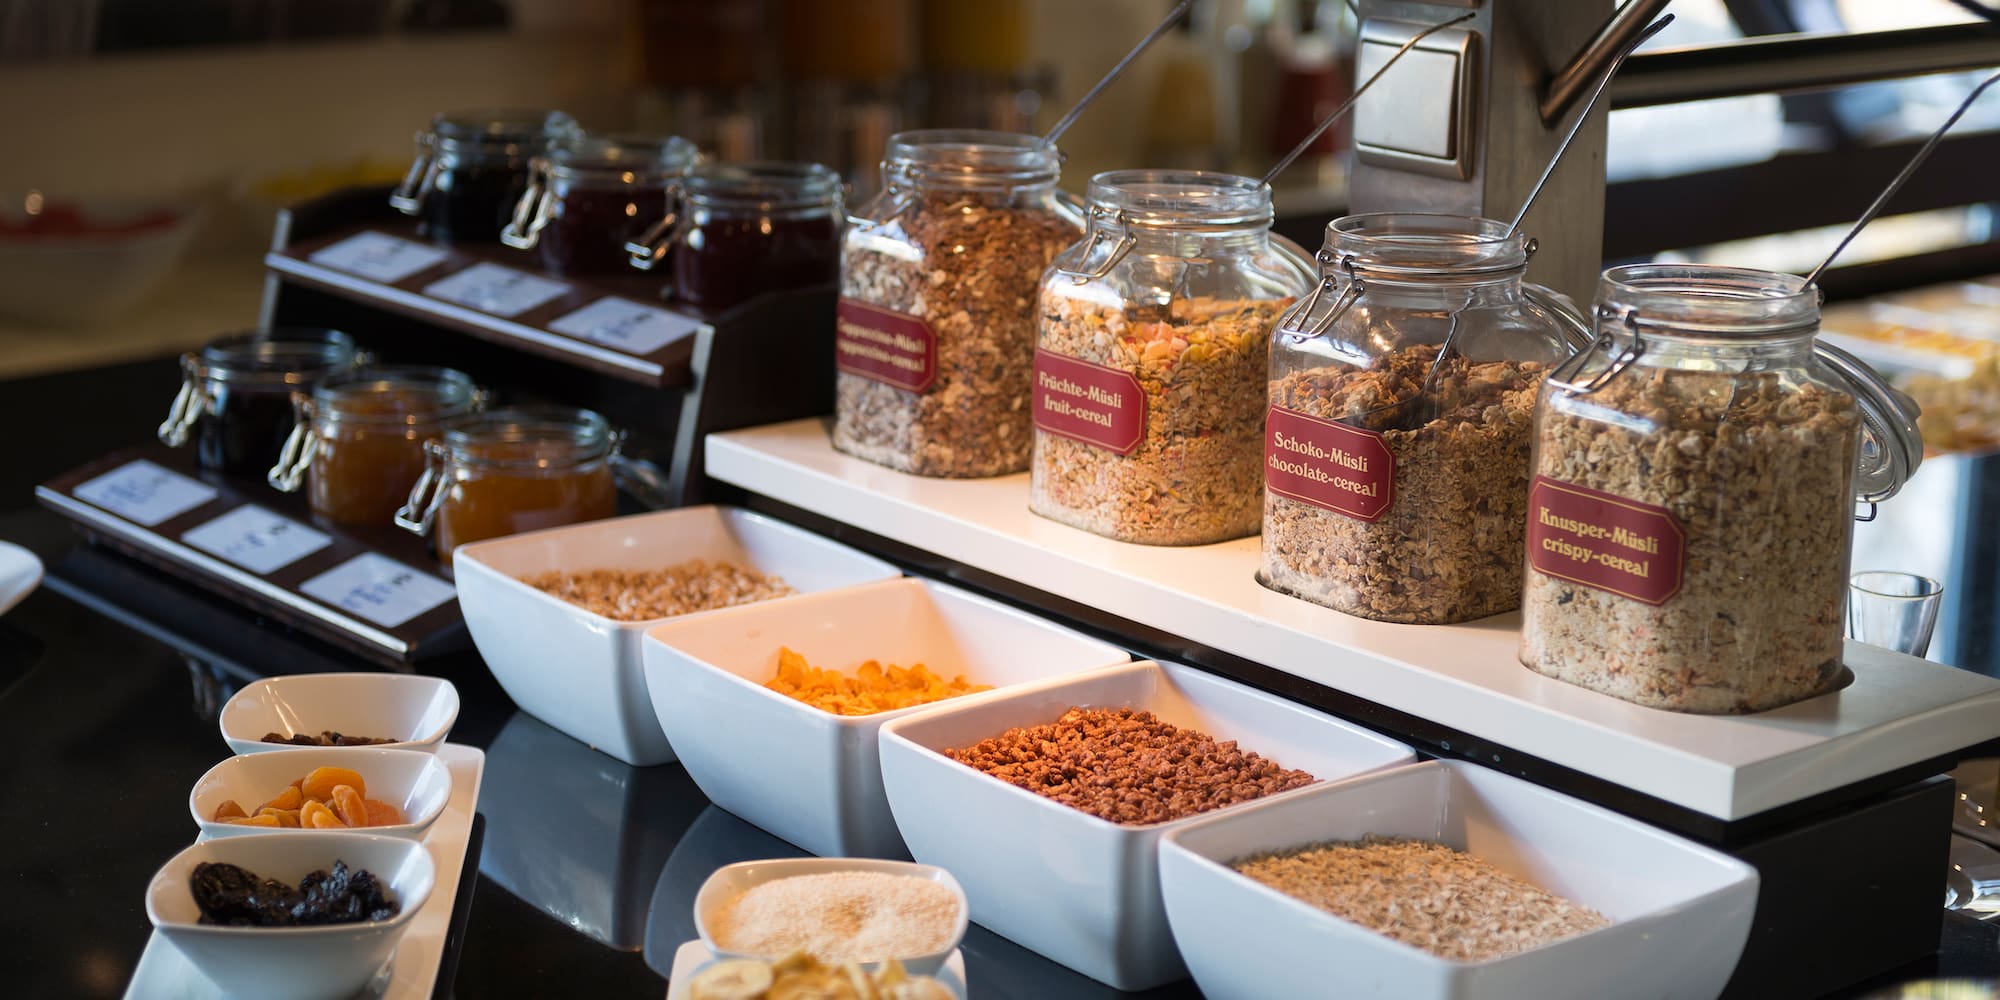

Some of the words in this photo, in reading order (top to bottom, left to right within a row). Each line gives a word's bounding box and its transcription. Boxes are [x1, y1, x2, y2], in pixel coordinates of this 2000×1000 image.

[1039, 371, 1122, 408] Früchte-Müsli
[1044, 394, 1112, 427] fruit-cereal
[1274, 431, 1368, 472] Schoko-Müsli
[1268, 453, 1377, 497] chocolate-cereal
[1539, 506, 1658, 554] Knusper-Müsli
[1542, 538, 1649, 577] crispy-cereal
